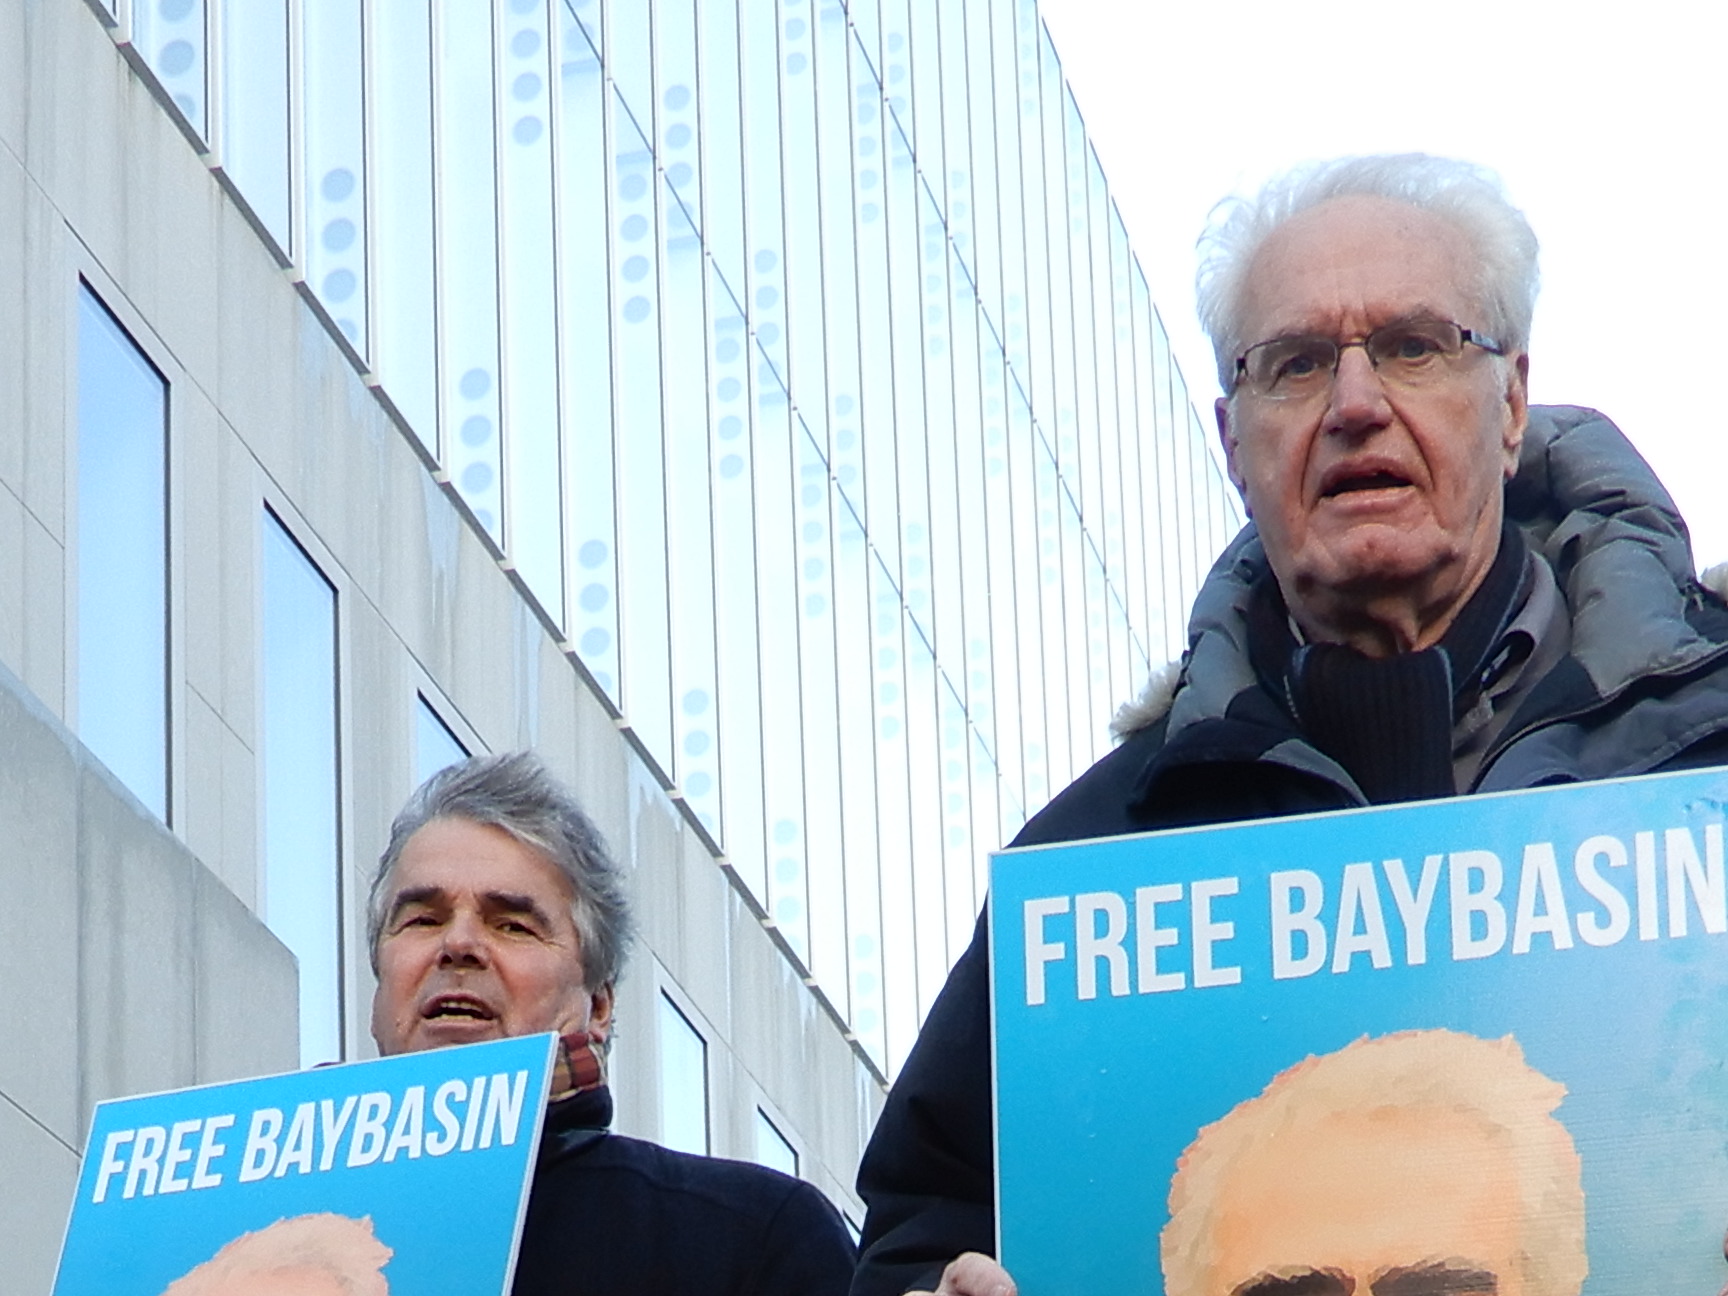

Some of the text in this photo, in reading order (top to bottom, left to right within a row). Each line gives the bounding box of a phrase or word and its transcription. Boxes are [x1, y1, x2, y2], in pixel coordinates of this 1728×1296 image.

[1023, 823, 1728, 1006] FREE BAYBASIN
[92, 1070, 529, 1204] FREE BAYBASIN
